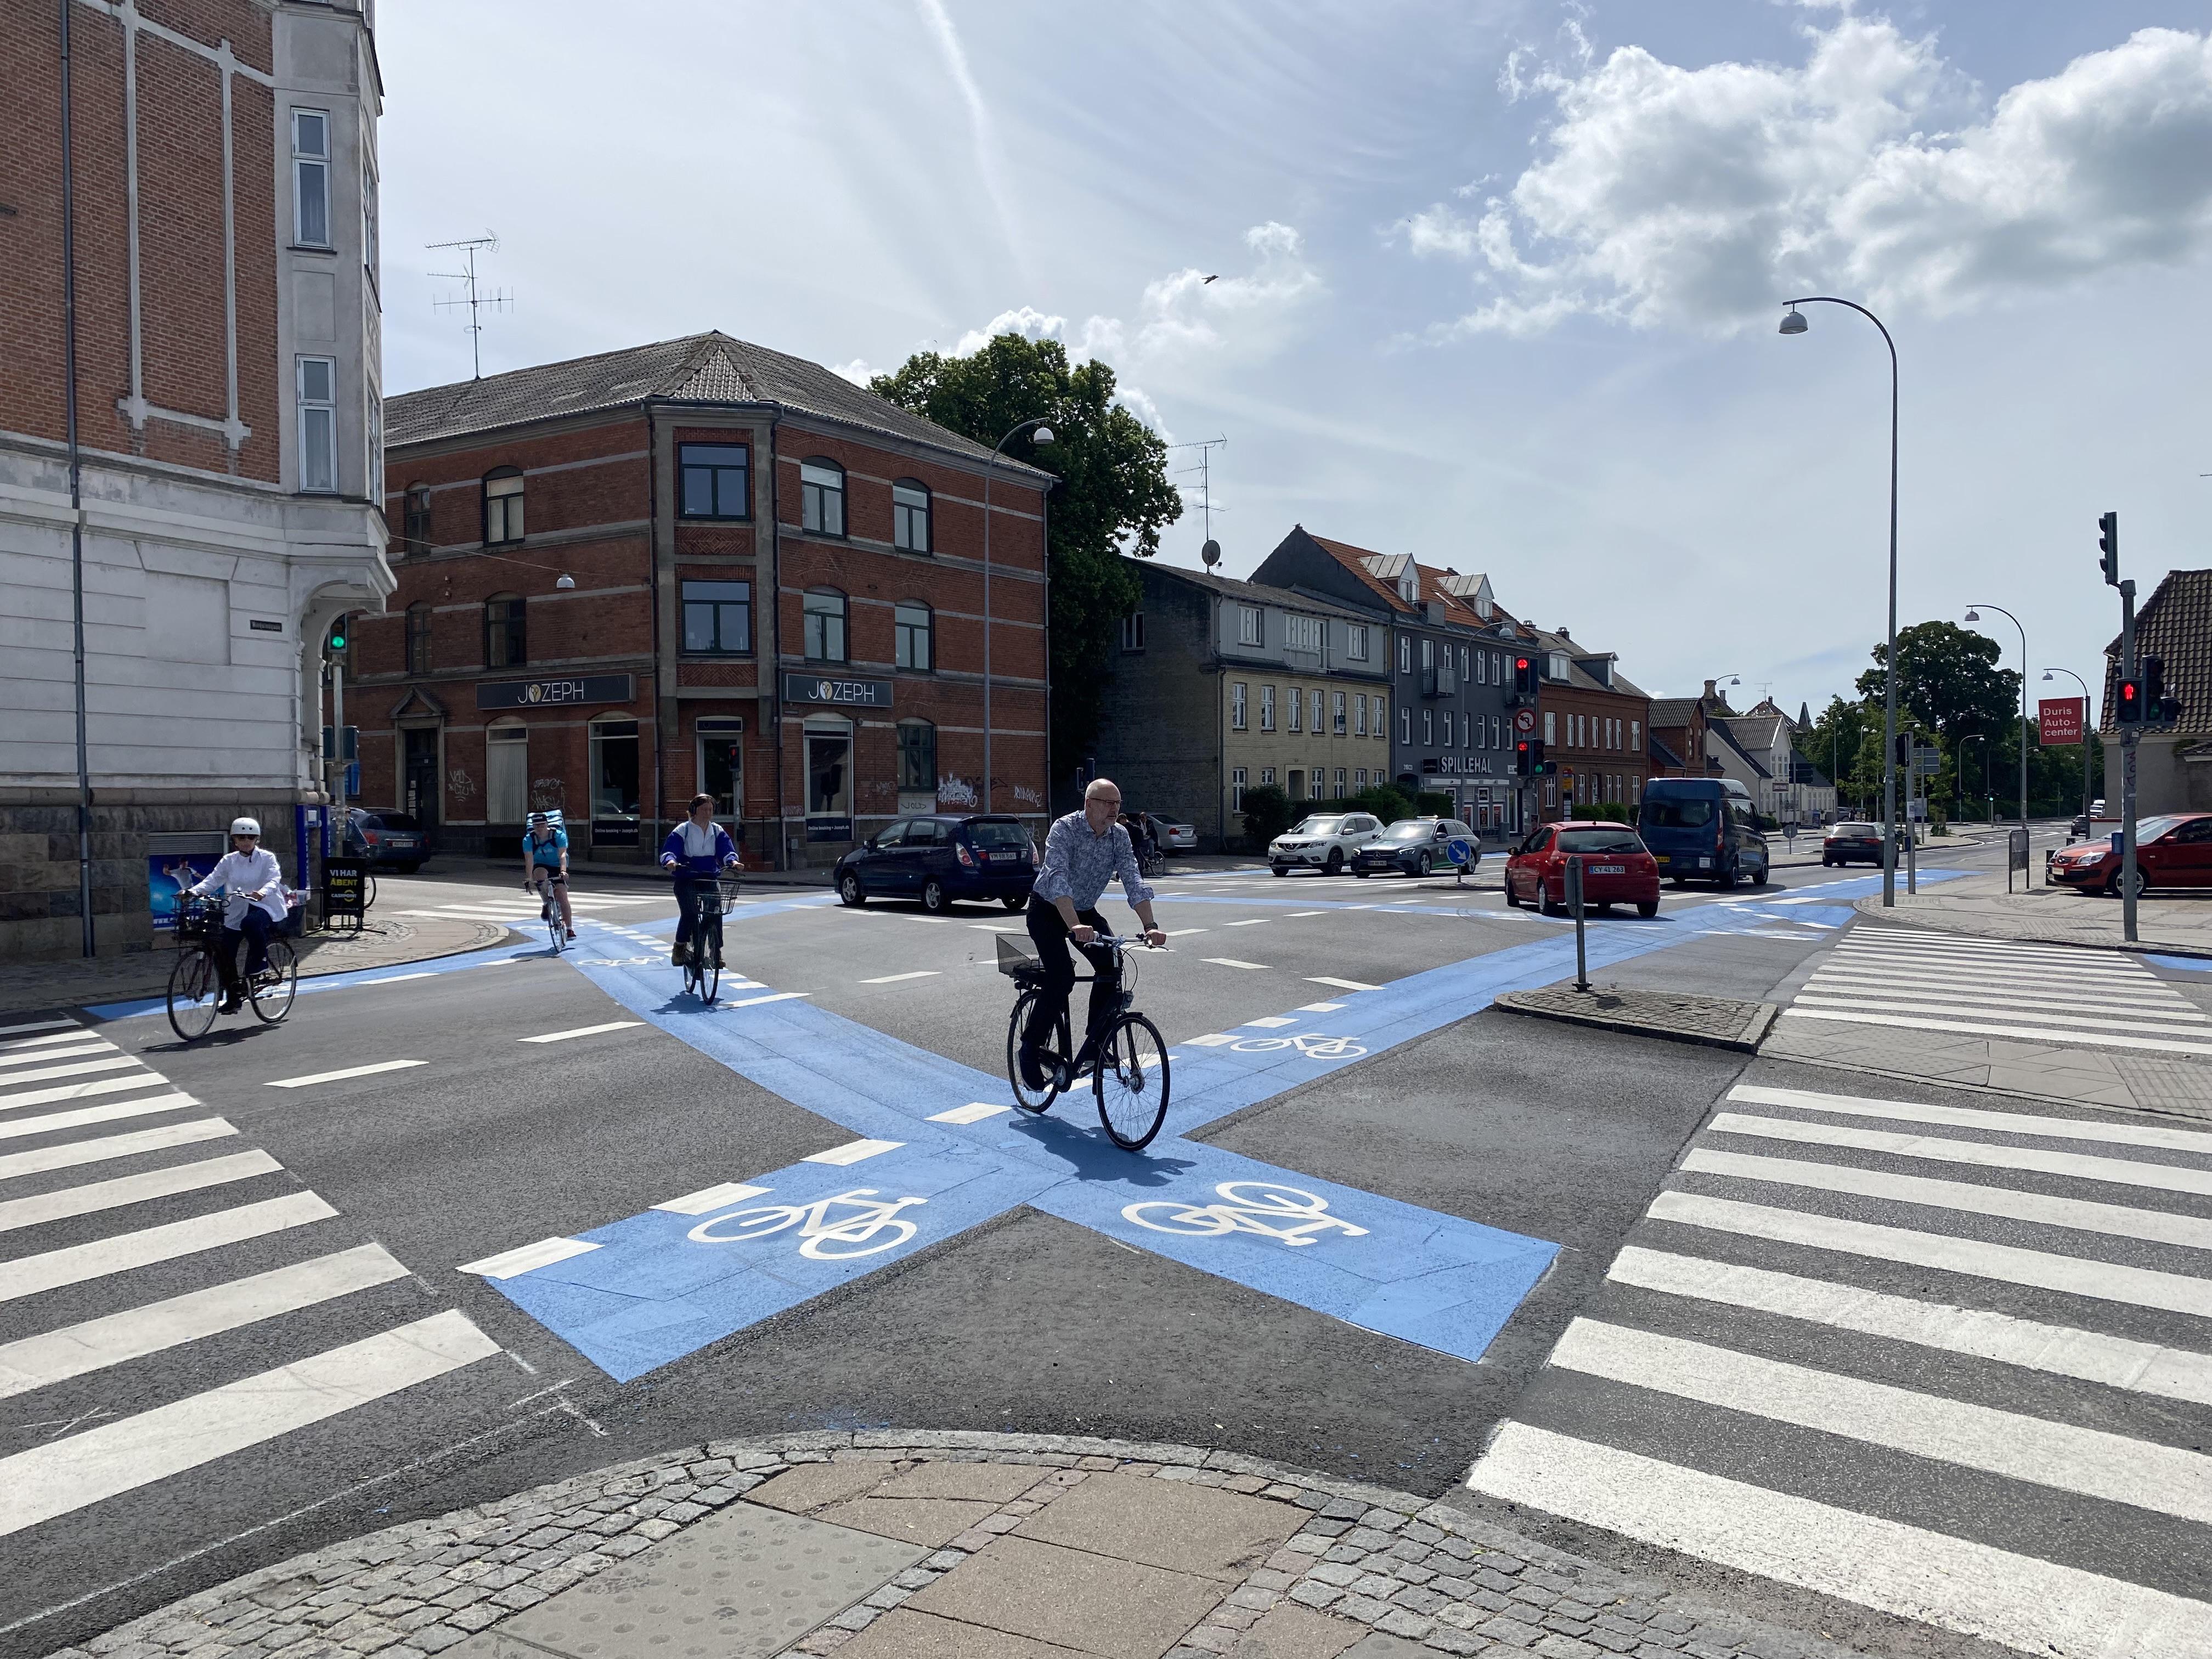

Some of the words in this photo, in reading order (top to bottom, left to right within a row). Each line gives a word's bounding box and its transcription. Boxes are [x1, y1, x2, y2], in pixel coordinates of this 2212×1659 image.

[517, 681, 584, 704] JOZEPH
[808, 680, 874, 702] JOZEPH
[2043, 707, 2072, 716] Duris
[2044, 718, 2076, 727] Auto-
[2045, 728, 2078, 736] center
[1441, 756, 1492, 773] SPILLEHAL
[330, 878, 358, 886] ÅBENT
